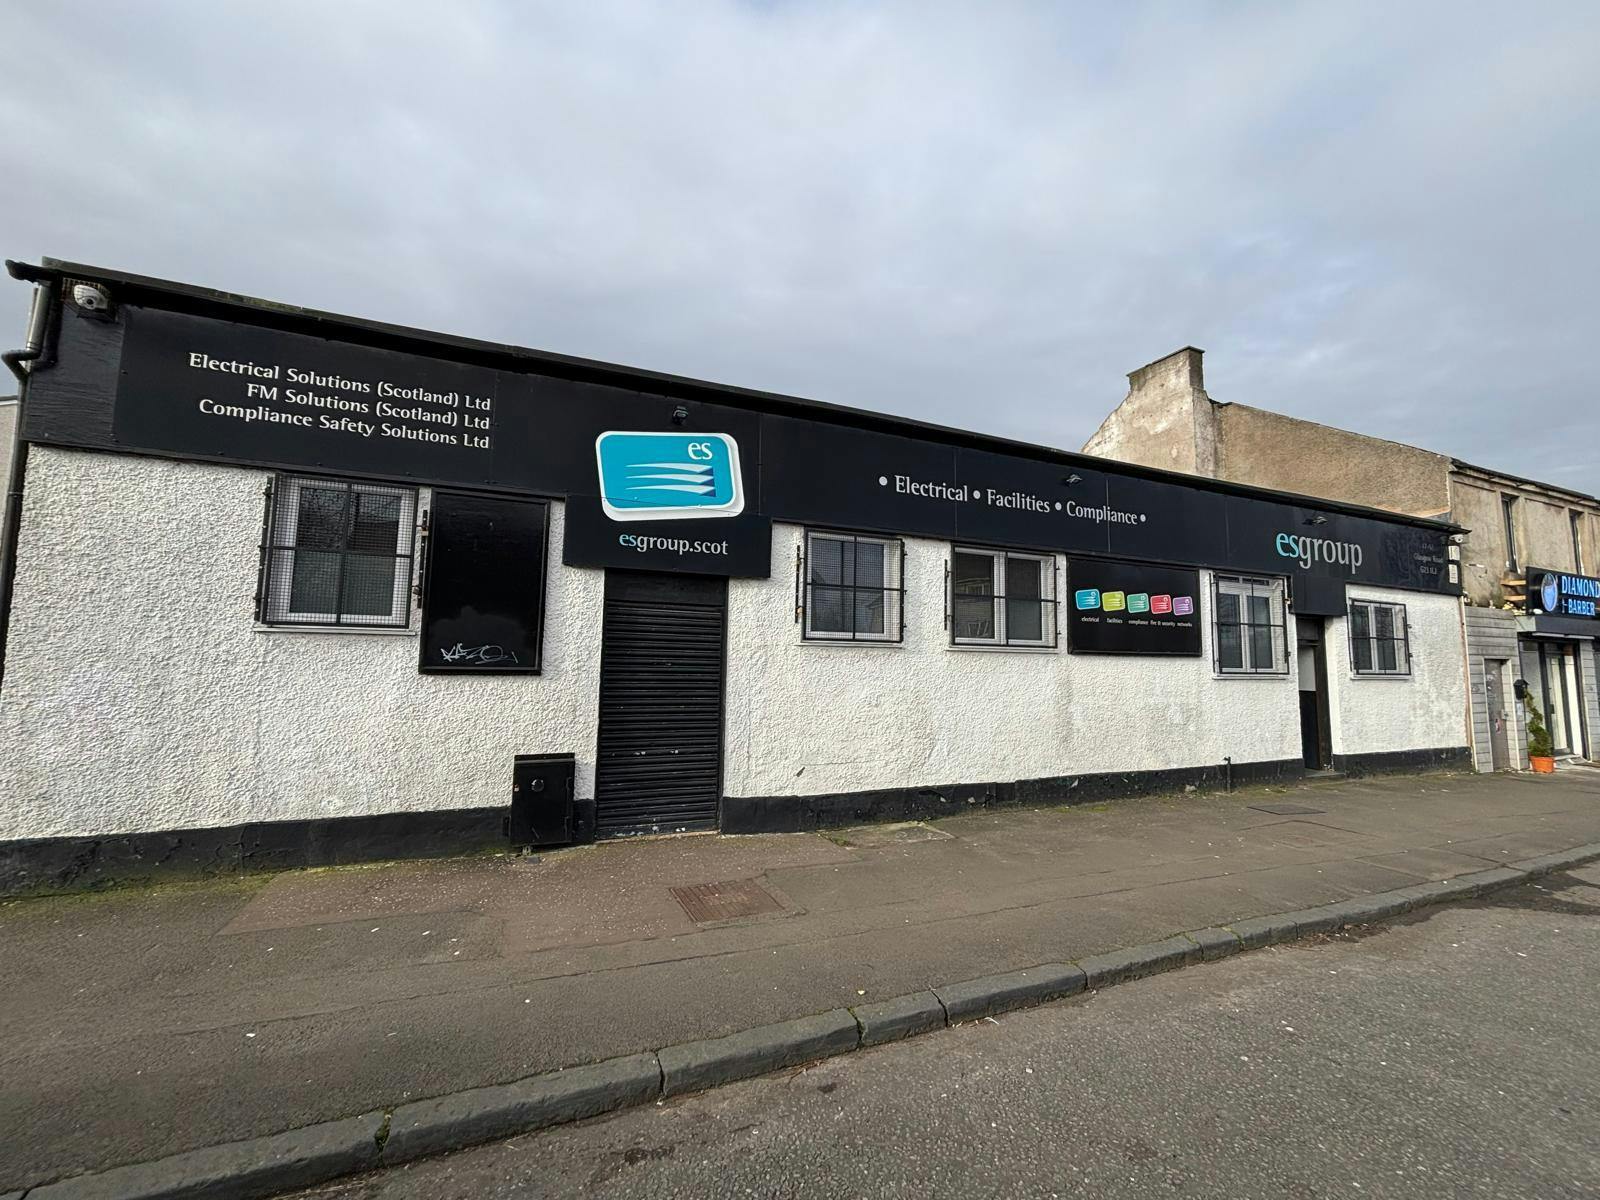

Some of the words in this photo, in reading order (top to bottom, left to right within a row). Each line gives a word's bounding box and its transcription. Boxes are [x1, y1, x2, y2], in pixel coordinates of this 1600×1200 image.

[189, 352, 280, 380] Electrical
[286, 368, 371, 394] Solutions
[377, 381, 459, 408] (Scotland)
[465, 395, 491, 411] Ltd
[199, 398, 313, 427] Compliance
[319, 414, 376, 437] Safety
[380, 422, 457, 446] Solutions
[463, 433, 490, 449] Ltd
[247, 383, 278, 401] FM
[284, 389, 369, 414] Solutions
[375, 401, 458, 427] (Scotland)
[464, 414, 490, 430] Ltd
[687, 441, 713, 460] es
[894, 474, 968, 502] Electrical
[986, 488, 1051, 513] Facilities
[1066, 500, 1138, 525] Compliance
[618, 533, 729, 556] esgroup.scot
[1275, 532, 1363, 574] esgroup
[1561, 576, 1600, 597] DIAMOND
[1568, 598, 1595, 615] BARBER
